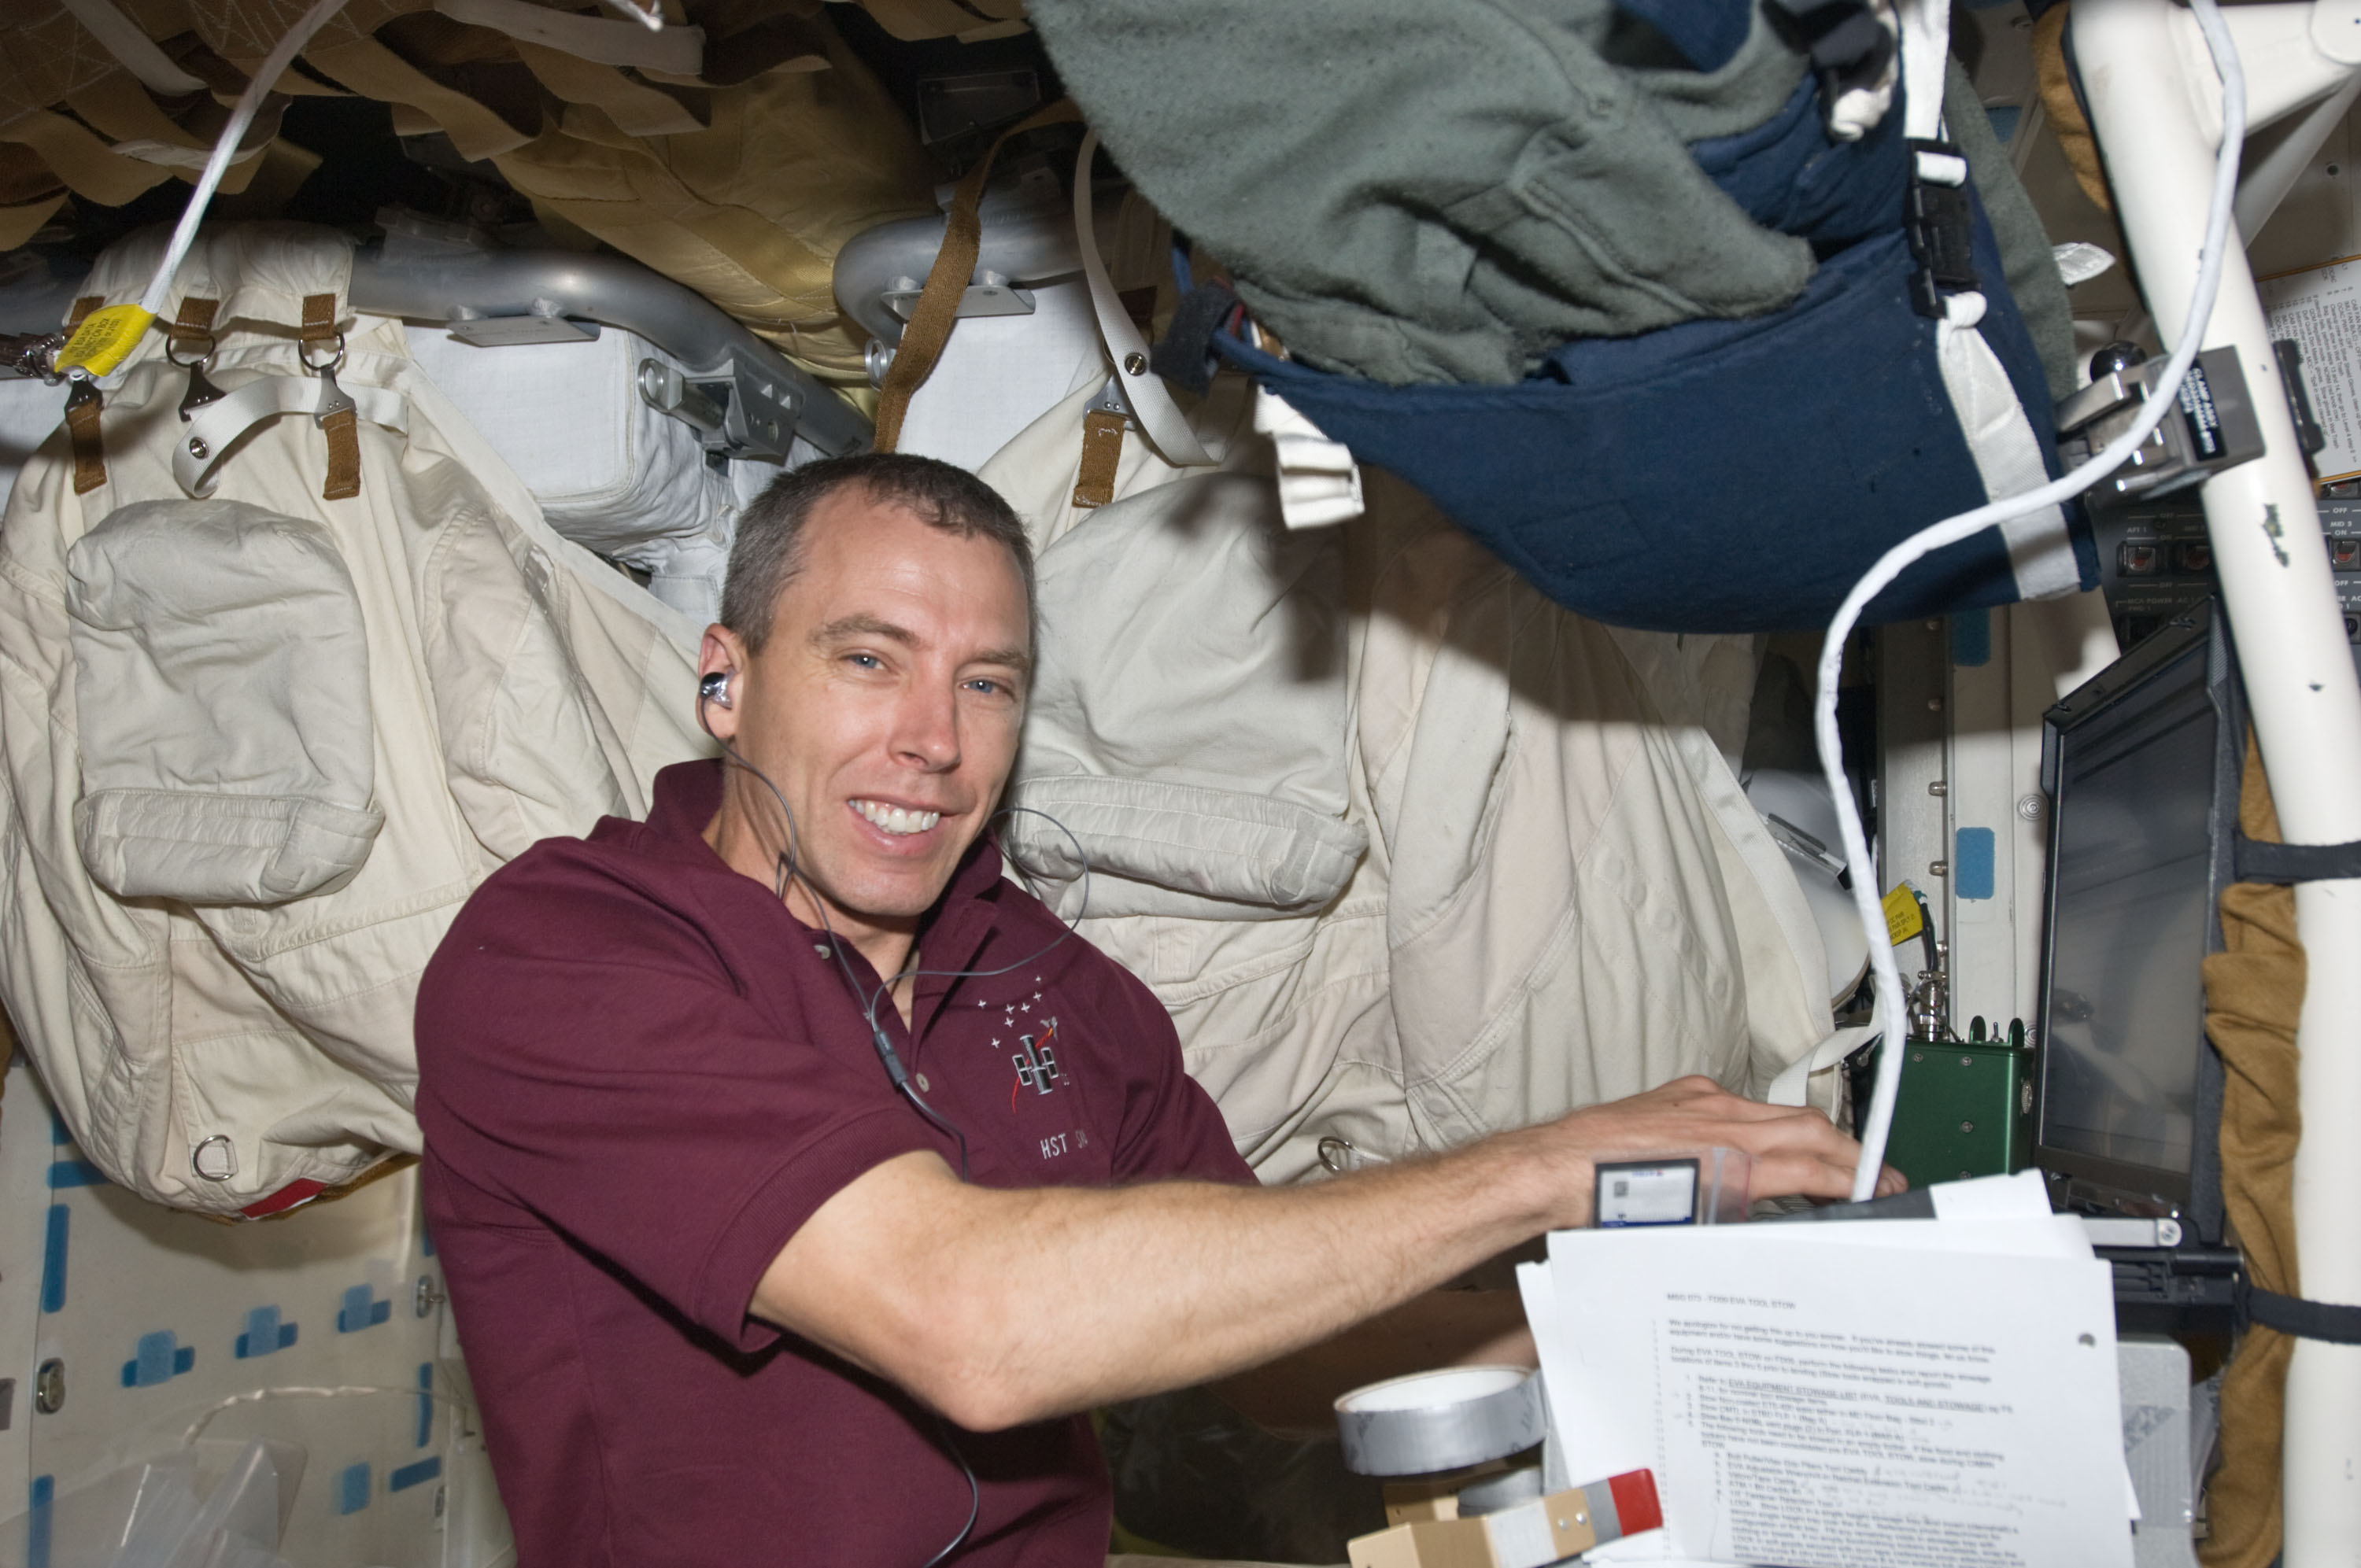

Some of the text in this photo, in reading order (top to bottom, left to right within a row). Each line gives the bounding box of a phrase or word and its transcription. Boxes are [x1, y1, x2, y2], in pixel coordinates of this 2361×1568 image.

[2322, 366, 2332, 384] NORM
[2336, 361, 2344, 377] Trash
[2304, 320, 2313, 335] Quick
[2321, 400, 2332, 417] gloves
[2330, 434, 2340, 449] Trash
[2319, 330, 2331, 351] perform
[2342, 418, 2351, 433] Level
[1040, 1133, 1068, 1160] HST
[1729, 1297, 1746, 1305] EVA
[1748, 1298, 1769, 1307] TOOL
[1771, 1301, 1796, 1309] STOW
[1715, 1349, 1736, 1358] TOOL
[1737, 1352, 1761, 1360] STOW
[1728, 1378, 1746, 1388] EVA
[1746, 1380, 1794, 1394] EQUIPMENT
[1795, 1386, 1837, 1400] STOWAGE
